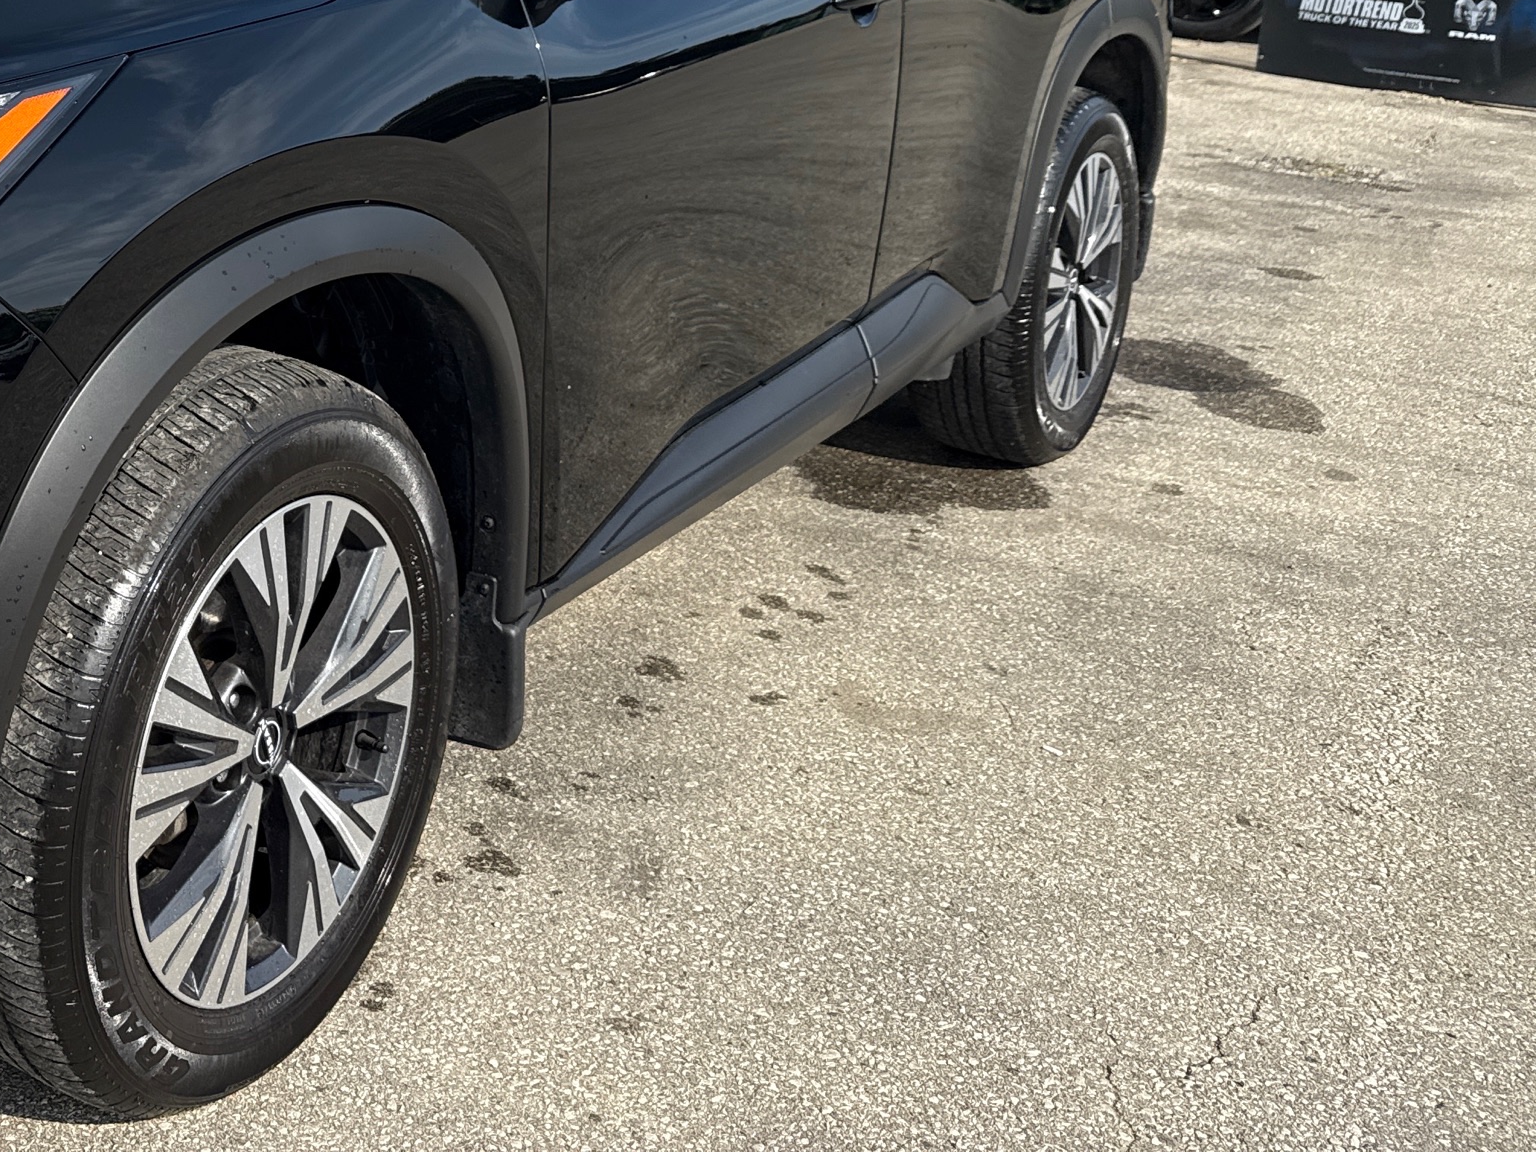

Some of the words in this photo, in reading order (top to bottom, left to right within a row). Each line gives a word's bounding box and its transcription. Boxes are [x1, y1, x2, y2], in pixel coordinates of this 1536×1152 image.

[1298, 11, 1331, 24] TRUCK
[1332, 15, 1348, 26] OF
[1349, 16, 1369, 29] THE
[1369, 19, 1400, 31] YEAR
[1448, 30, 1497, 42] RAM
